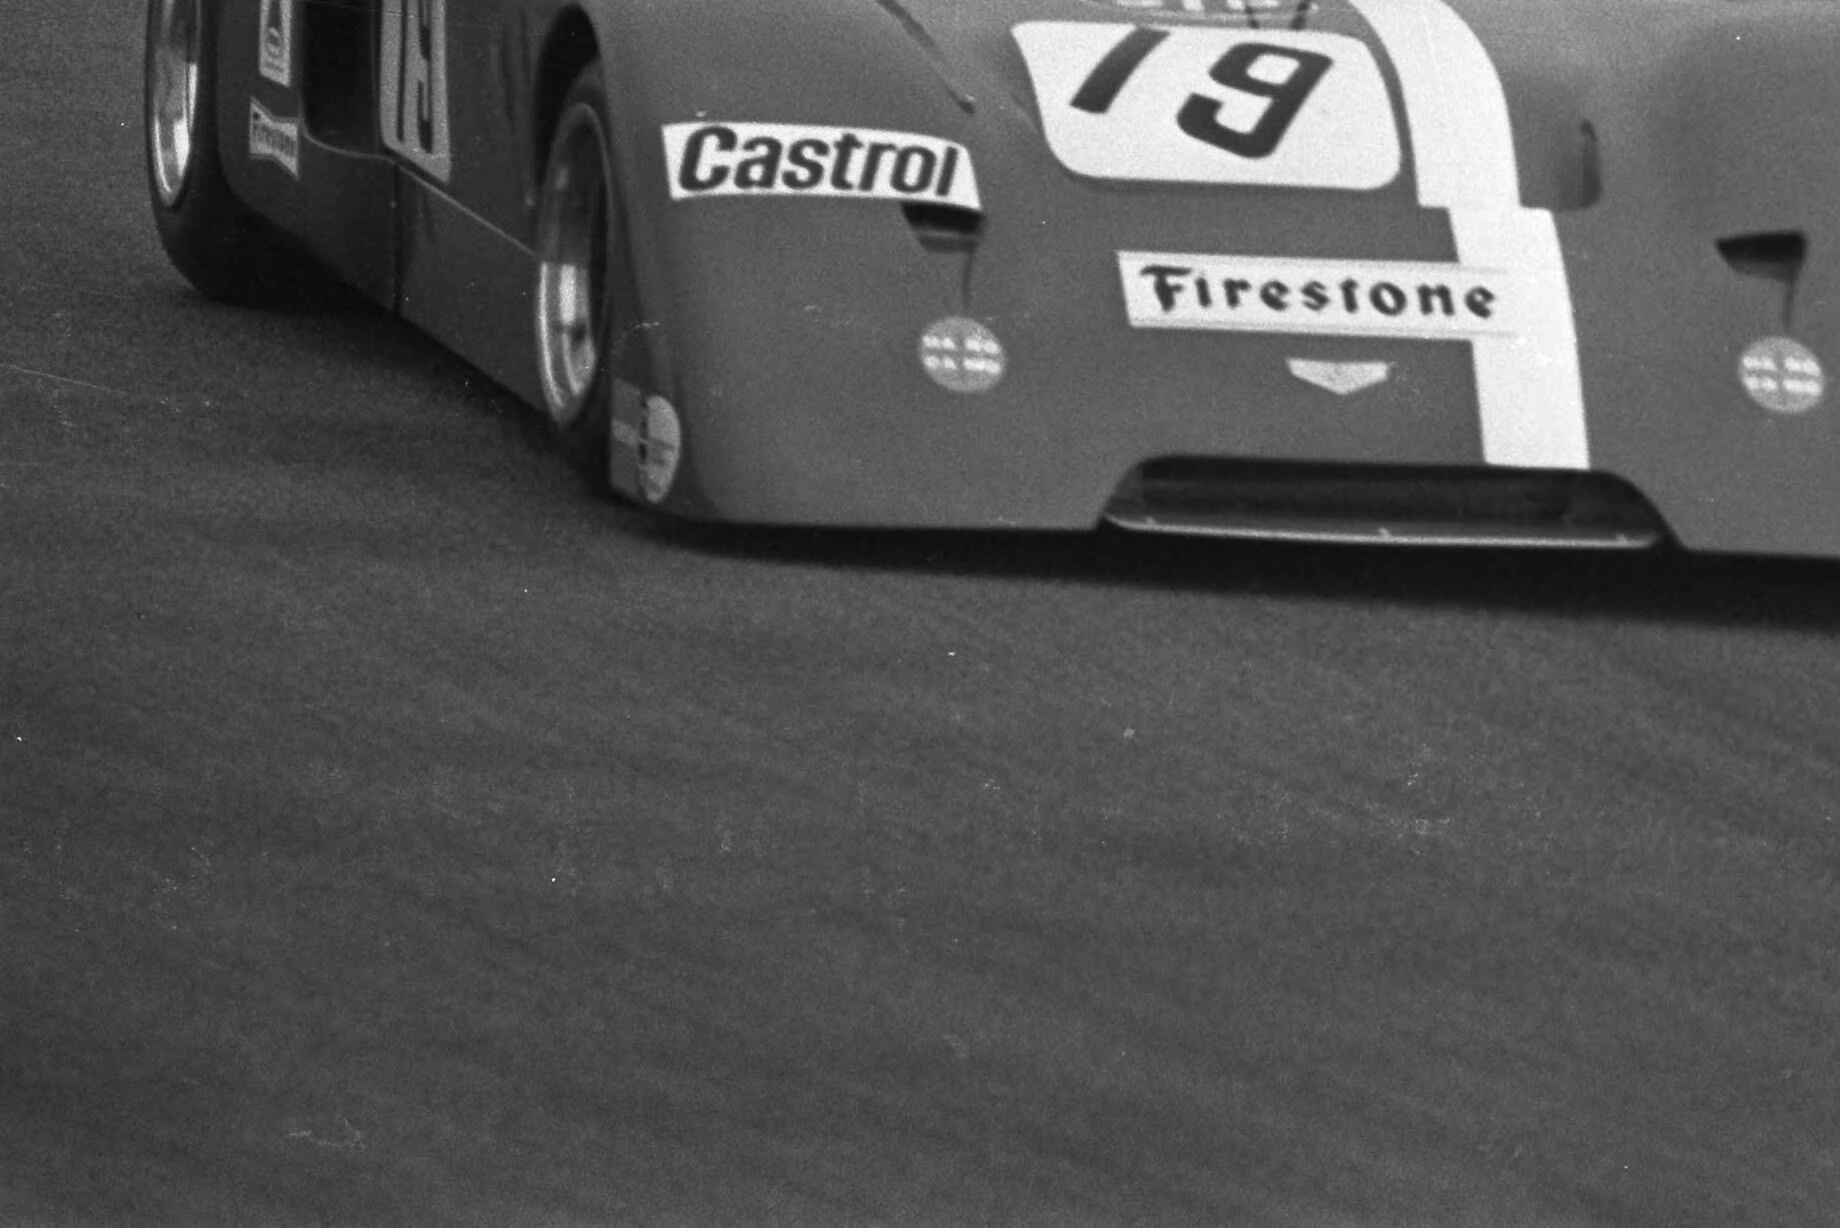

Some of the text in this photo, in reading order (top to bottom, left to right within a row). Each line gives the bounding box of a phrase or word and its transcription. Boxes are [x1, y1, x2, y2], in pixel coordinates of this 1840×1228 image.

[1070, 25, 1335, 161] 19
[677, 126, 959, 197] Castrol
[1139, 263, 1497, 320] Firestone
